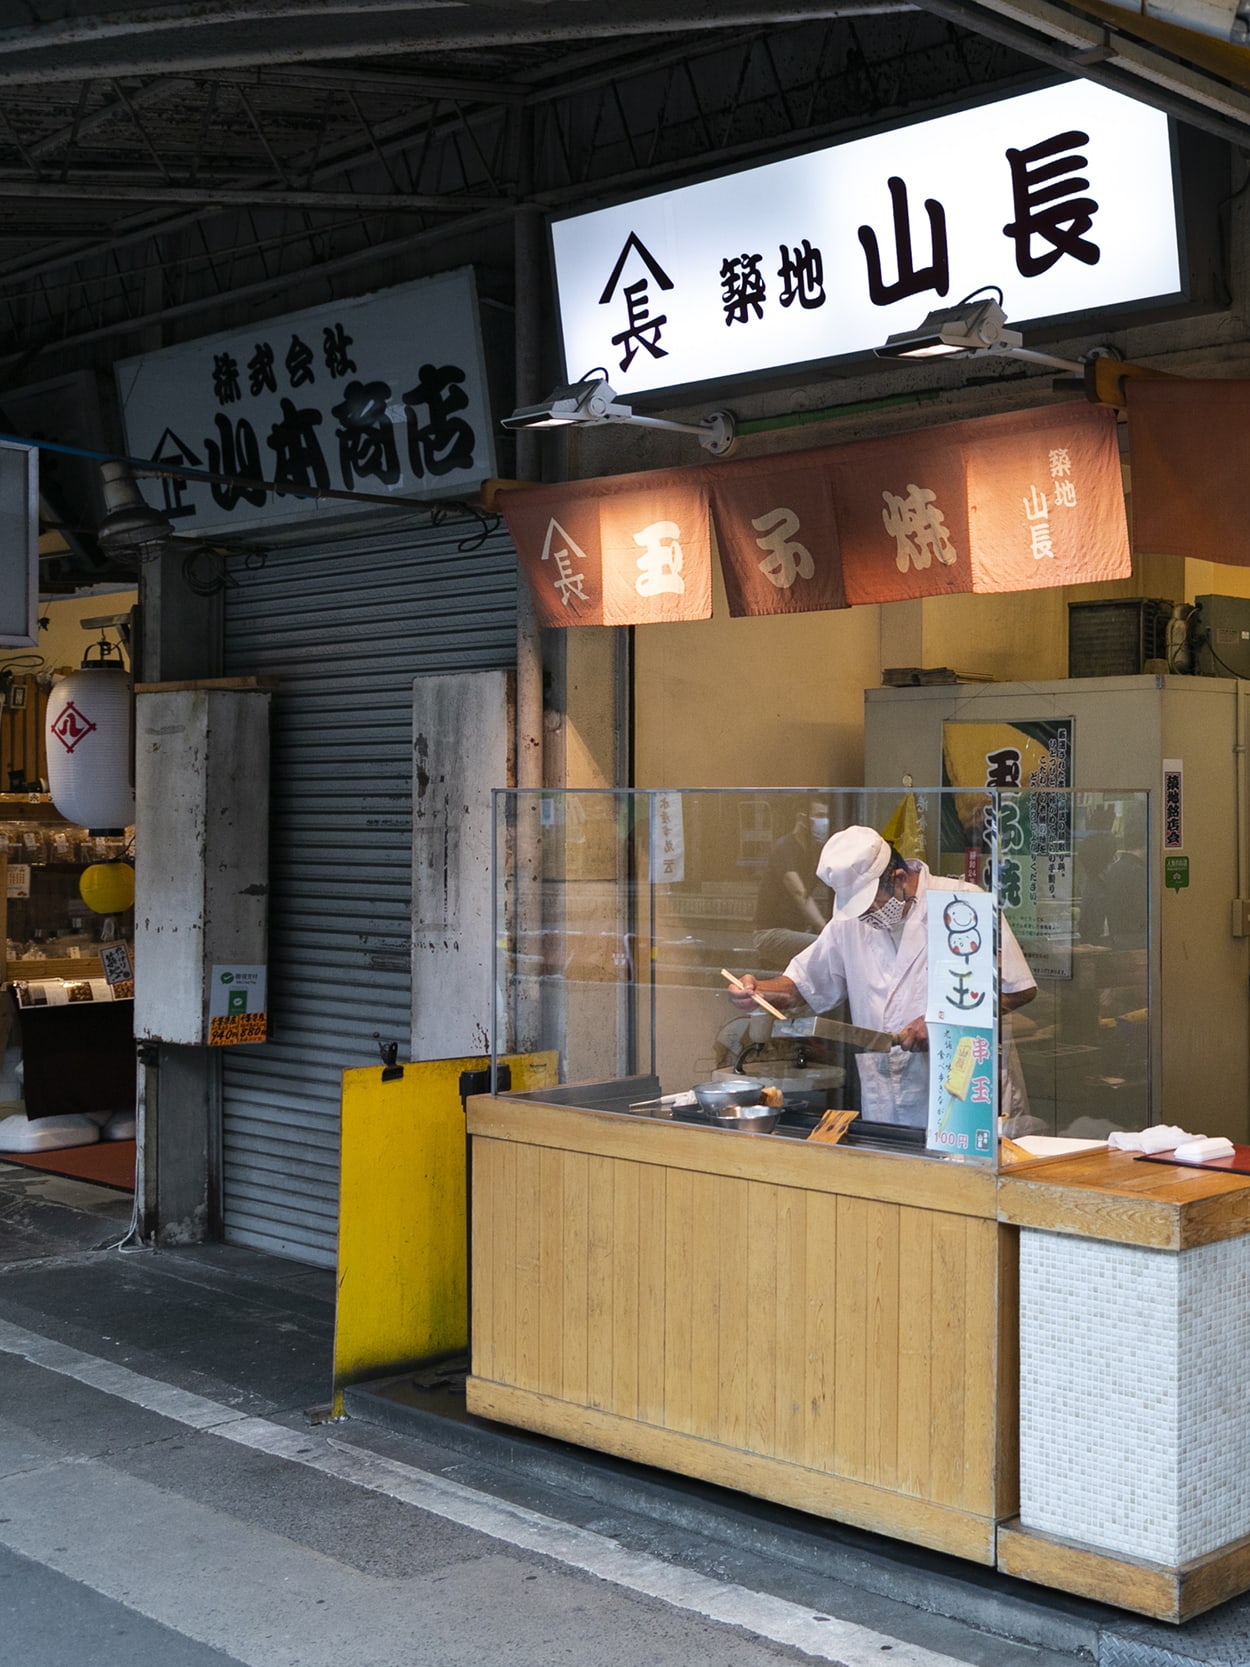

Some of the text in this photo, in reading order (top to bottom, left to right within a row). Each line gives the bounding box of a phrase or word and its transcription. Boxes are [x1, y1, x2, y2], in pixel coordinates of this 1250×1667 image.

[719, 130, 1101, 327] 築地 山長
[211, 322, 358, 406] 株式会社
[203, 363, 476, 512] 山本商店
[1048, 447, 1079, 508] 築地
[1023, 485, 1055, 560] 山長
[971, 1036, 991, 1104] 串玉
